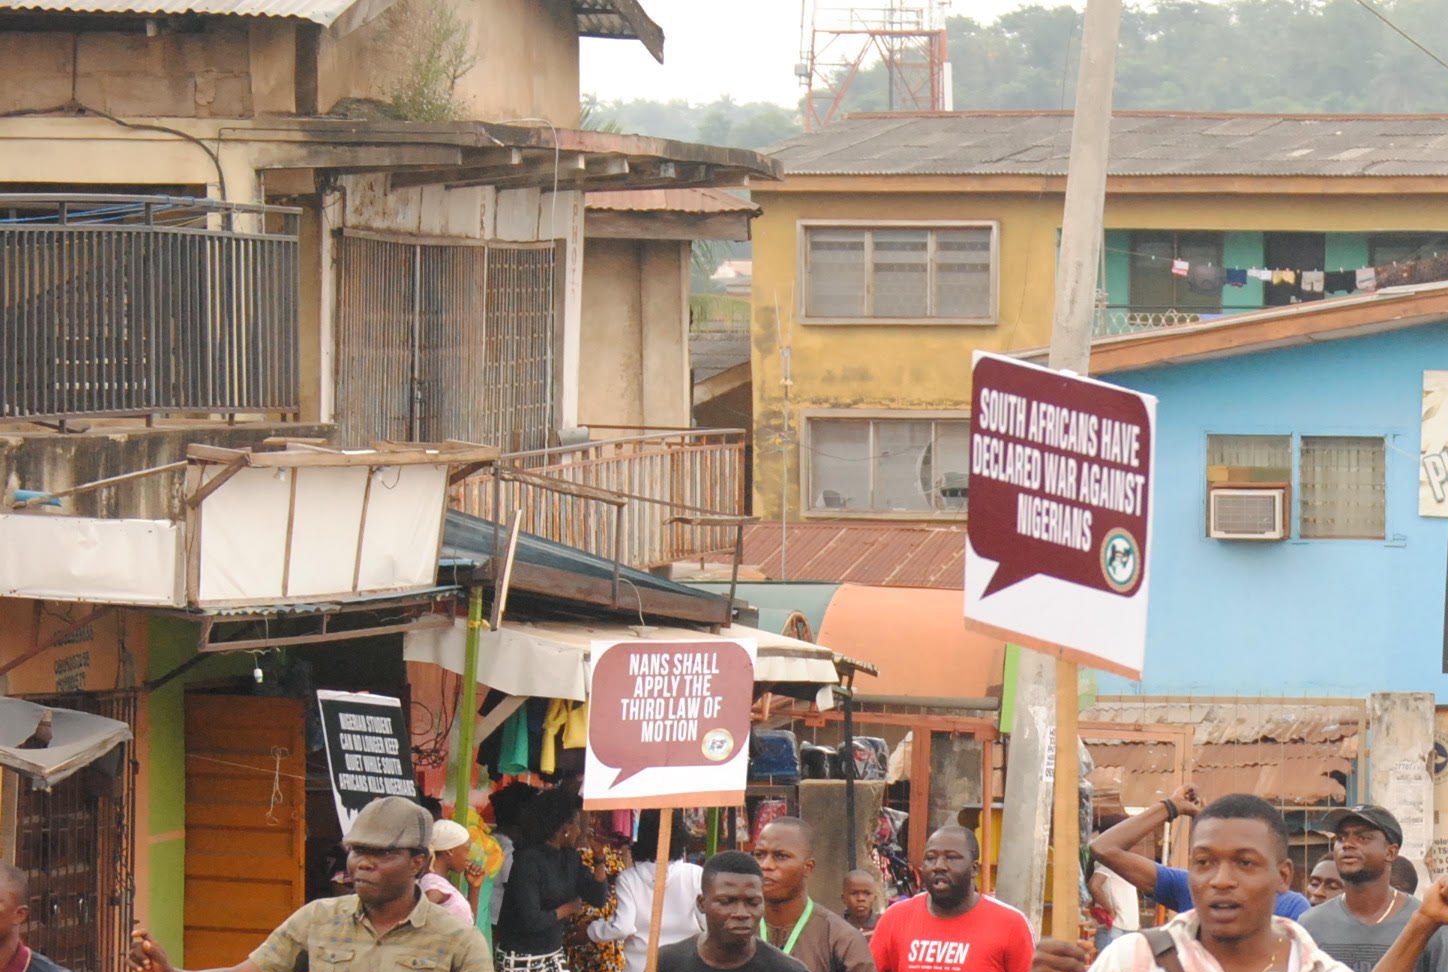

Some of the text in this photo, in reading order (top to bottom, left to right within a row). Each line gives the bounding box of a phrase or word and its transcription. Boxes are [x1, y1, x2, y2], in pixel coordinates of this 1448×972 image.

[980, 388, 1141, 466] SOUTH AFRICANS HAVE
[972, 433, 1145, 516] DECLARED WAR AGAINST
[1017, 494, 1092, 552] NIGERIANS
[629, 652, 720, 675] NANS SHALL
[633, 674, 712, 698] APPLY THE
[621, 696, 723, 720] THIRD LAW OF
[366, 714, 393, 734] STUDENT
[640, 720, 698, 743] MOTION
[362, 735, 385, 753] LONGER
[384, 738, 399, 755] KEEP
[382, 757, 403, 775] SOUTH
[339, 773, 368, 792] AFRICANS
[368, 775, 384, 794] KILLS
[907, 939, 970, 965] STEVEN
